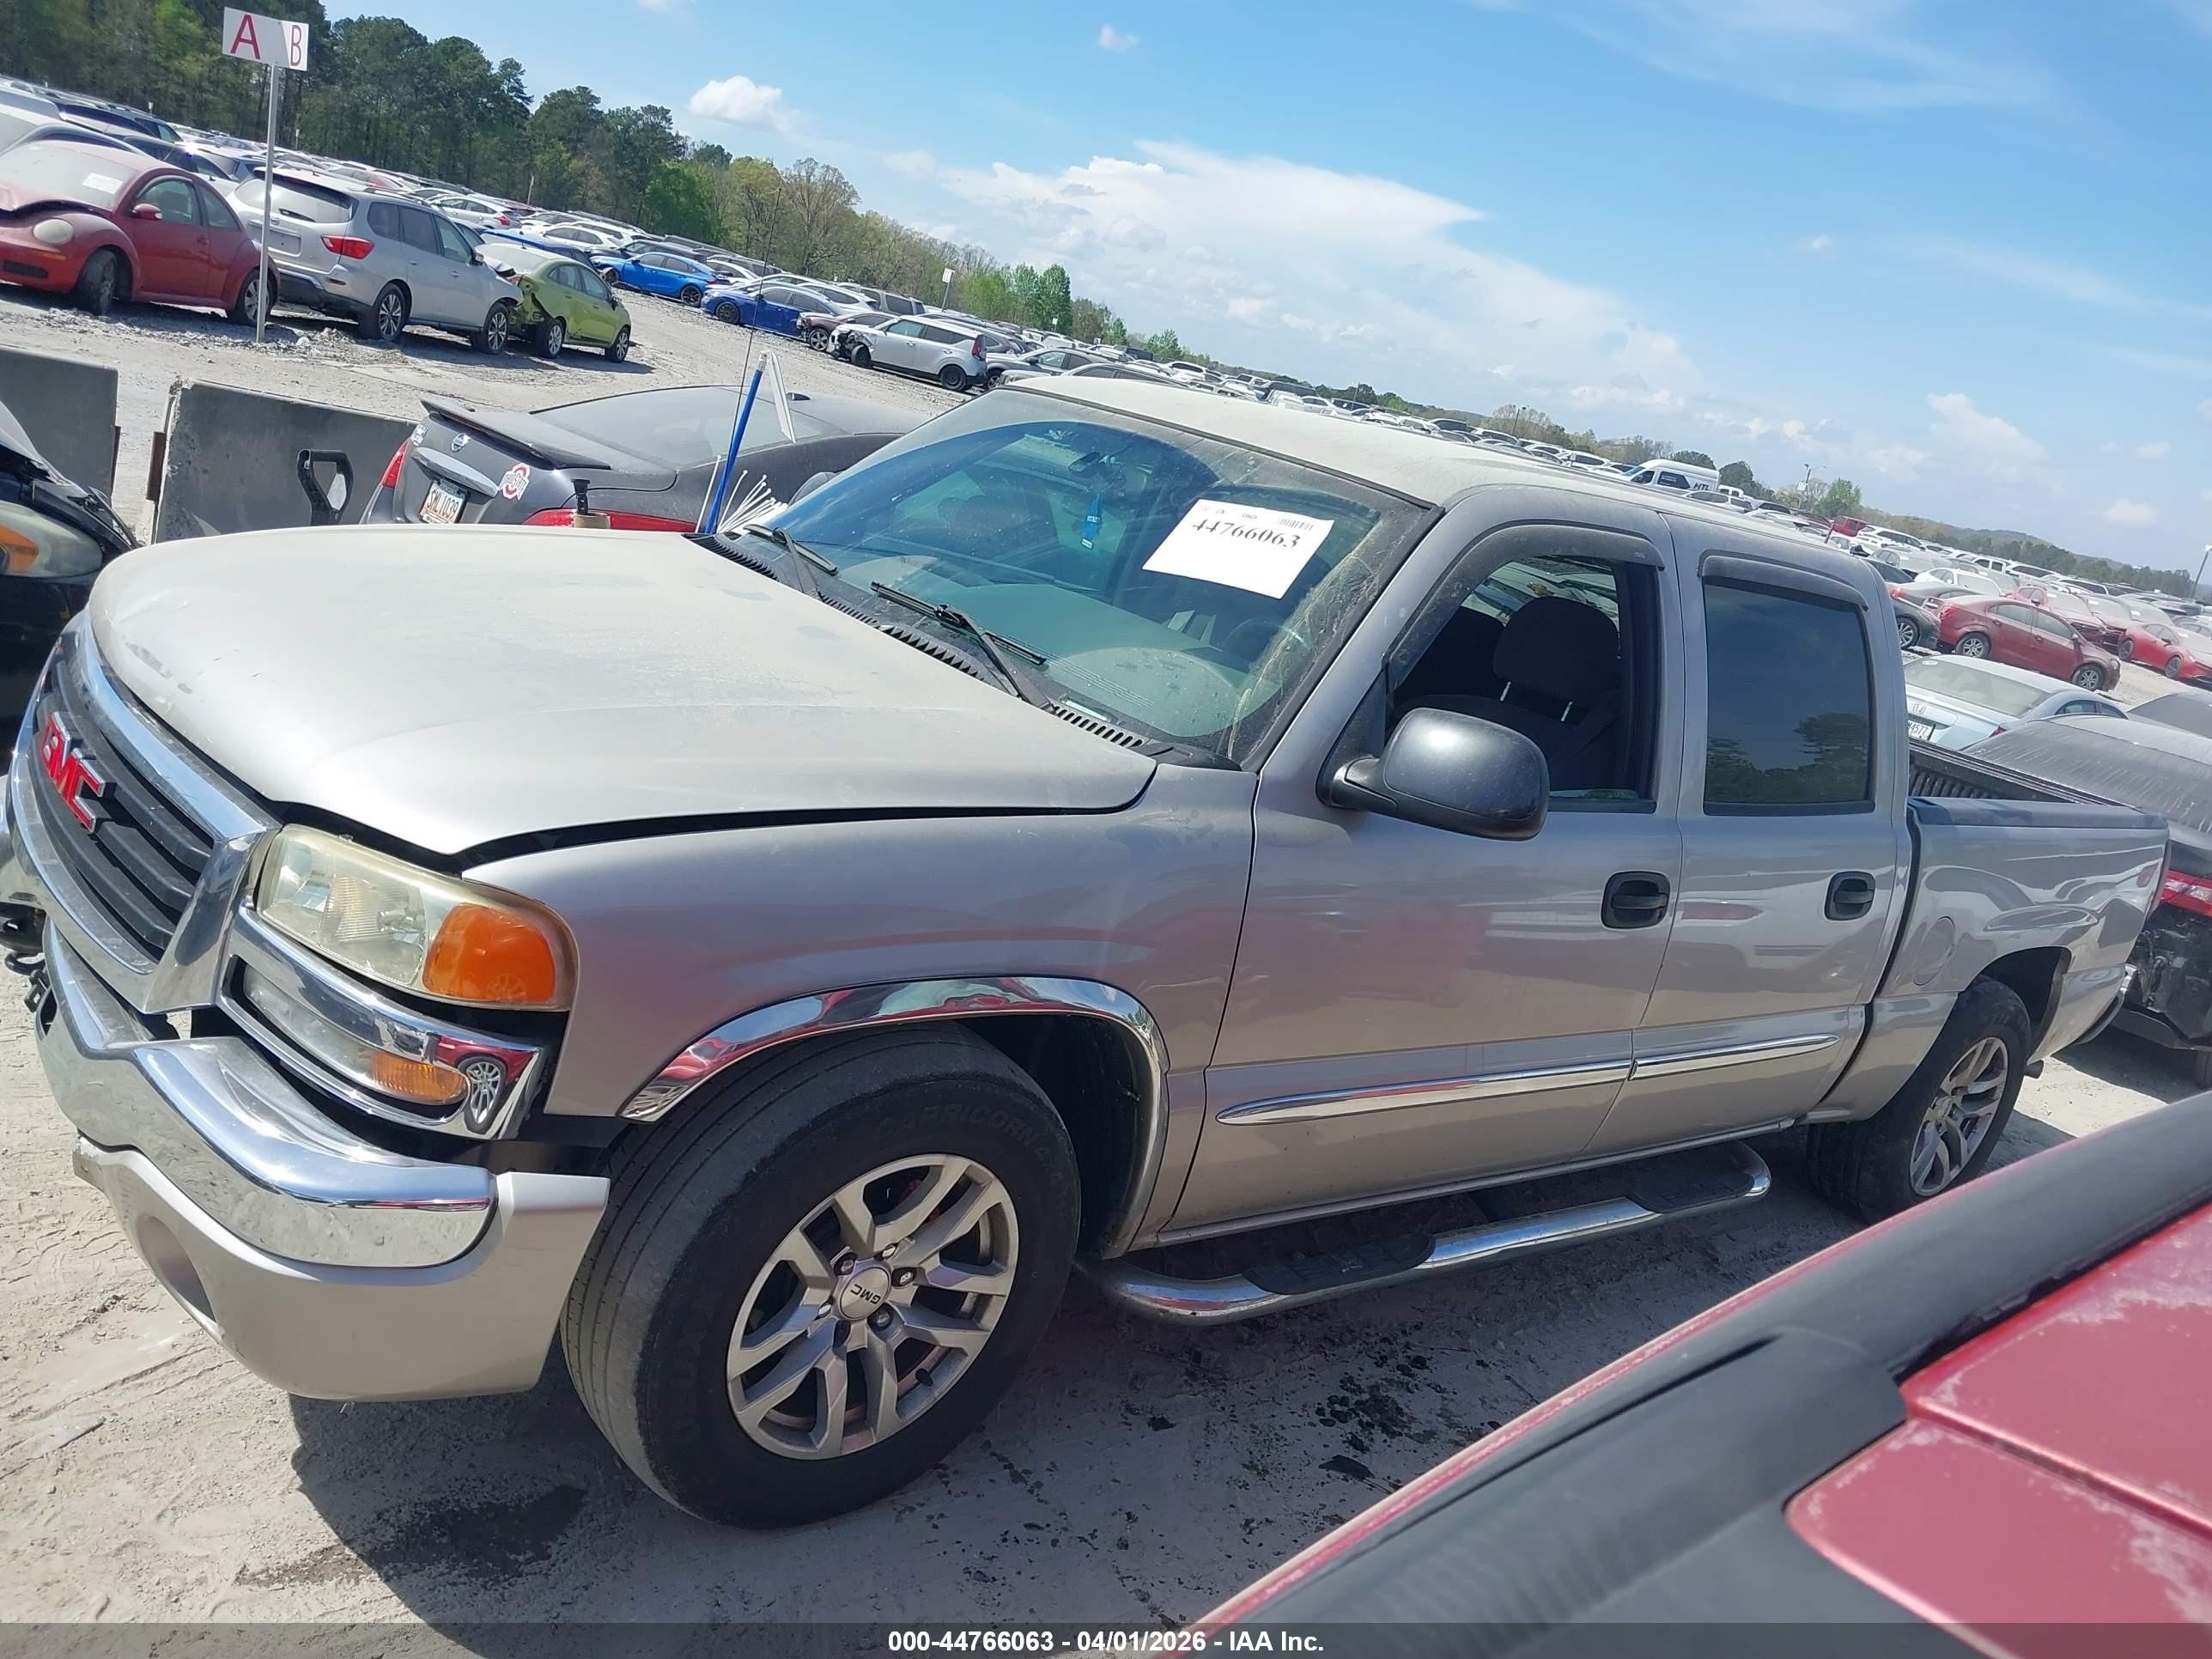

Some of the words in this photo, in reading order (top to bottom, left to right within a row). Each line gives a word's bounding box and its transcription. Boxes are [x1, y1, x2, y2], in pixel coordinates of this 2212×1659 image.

[229, 14, 261, 60] A
[290, 24, 302, 66] B
[1192, 519, 1301, 548] 44766063
[41, 711, 106, 834] GMC
[850, 1283, 881, 1305] GMC
